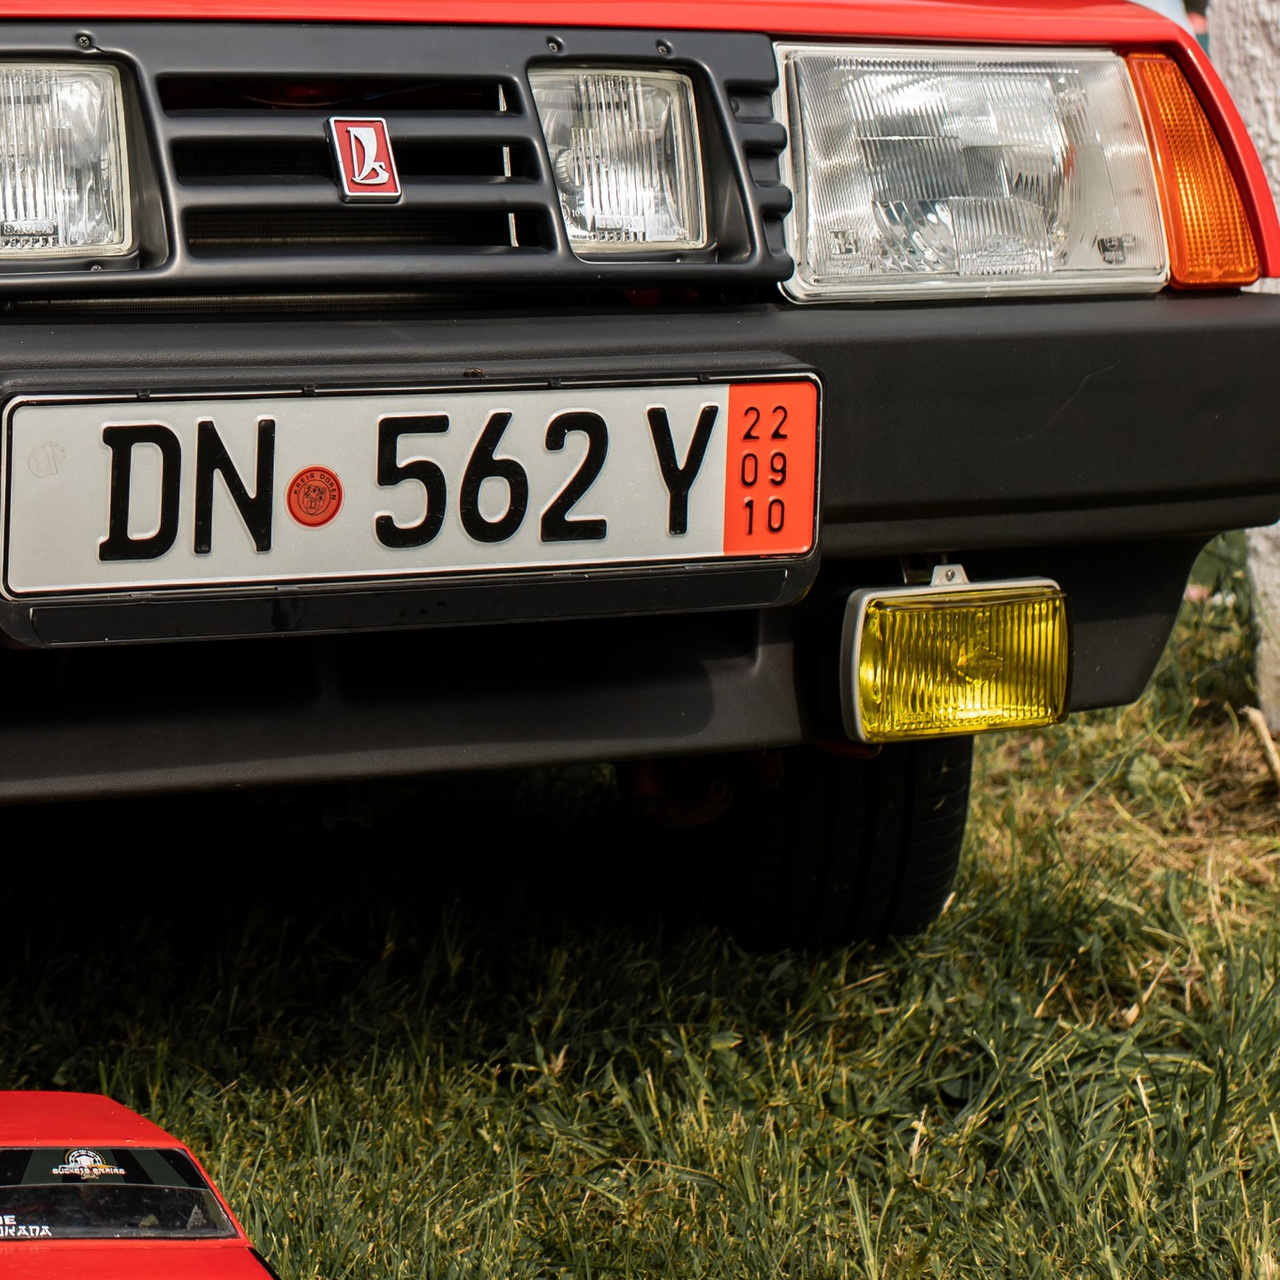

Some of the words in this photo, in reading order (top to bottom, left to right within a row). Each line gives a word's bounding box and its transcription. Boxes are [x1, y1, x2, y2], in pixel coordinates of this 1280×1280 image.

[742, 405, 788, 440] 22
[98, 416, 276, 563] DN
[373, 409, 610, 549] 562
[646, 403, 720, 536] Y
[740, 451, 787, 487] 09
[744, 498, 785, 536] 10
